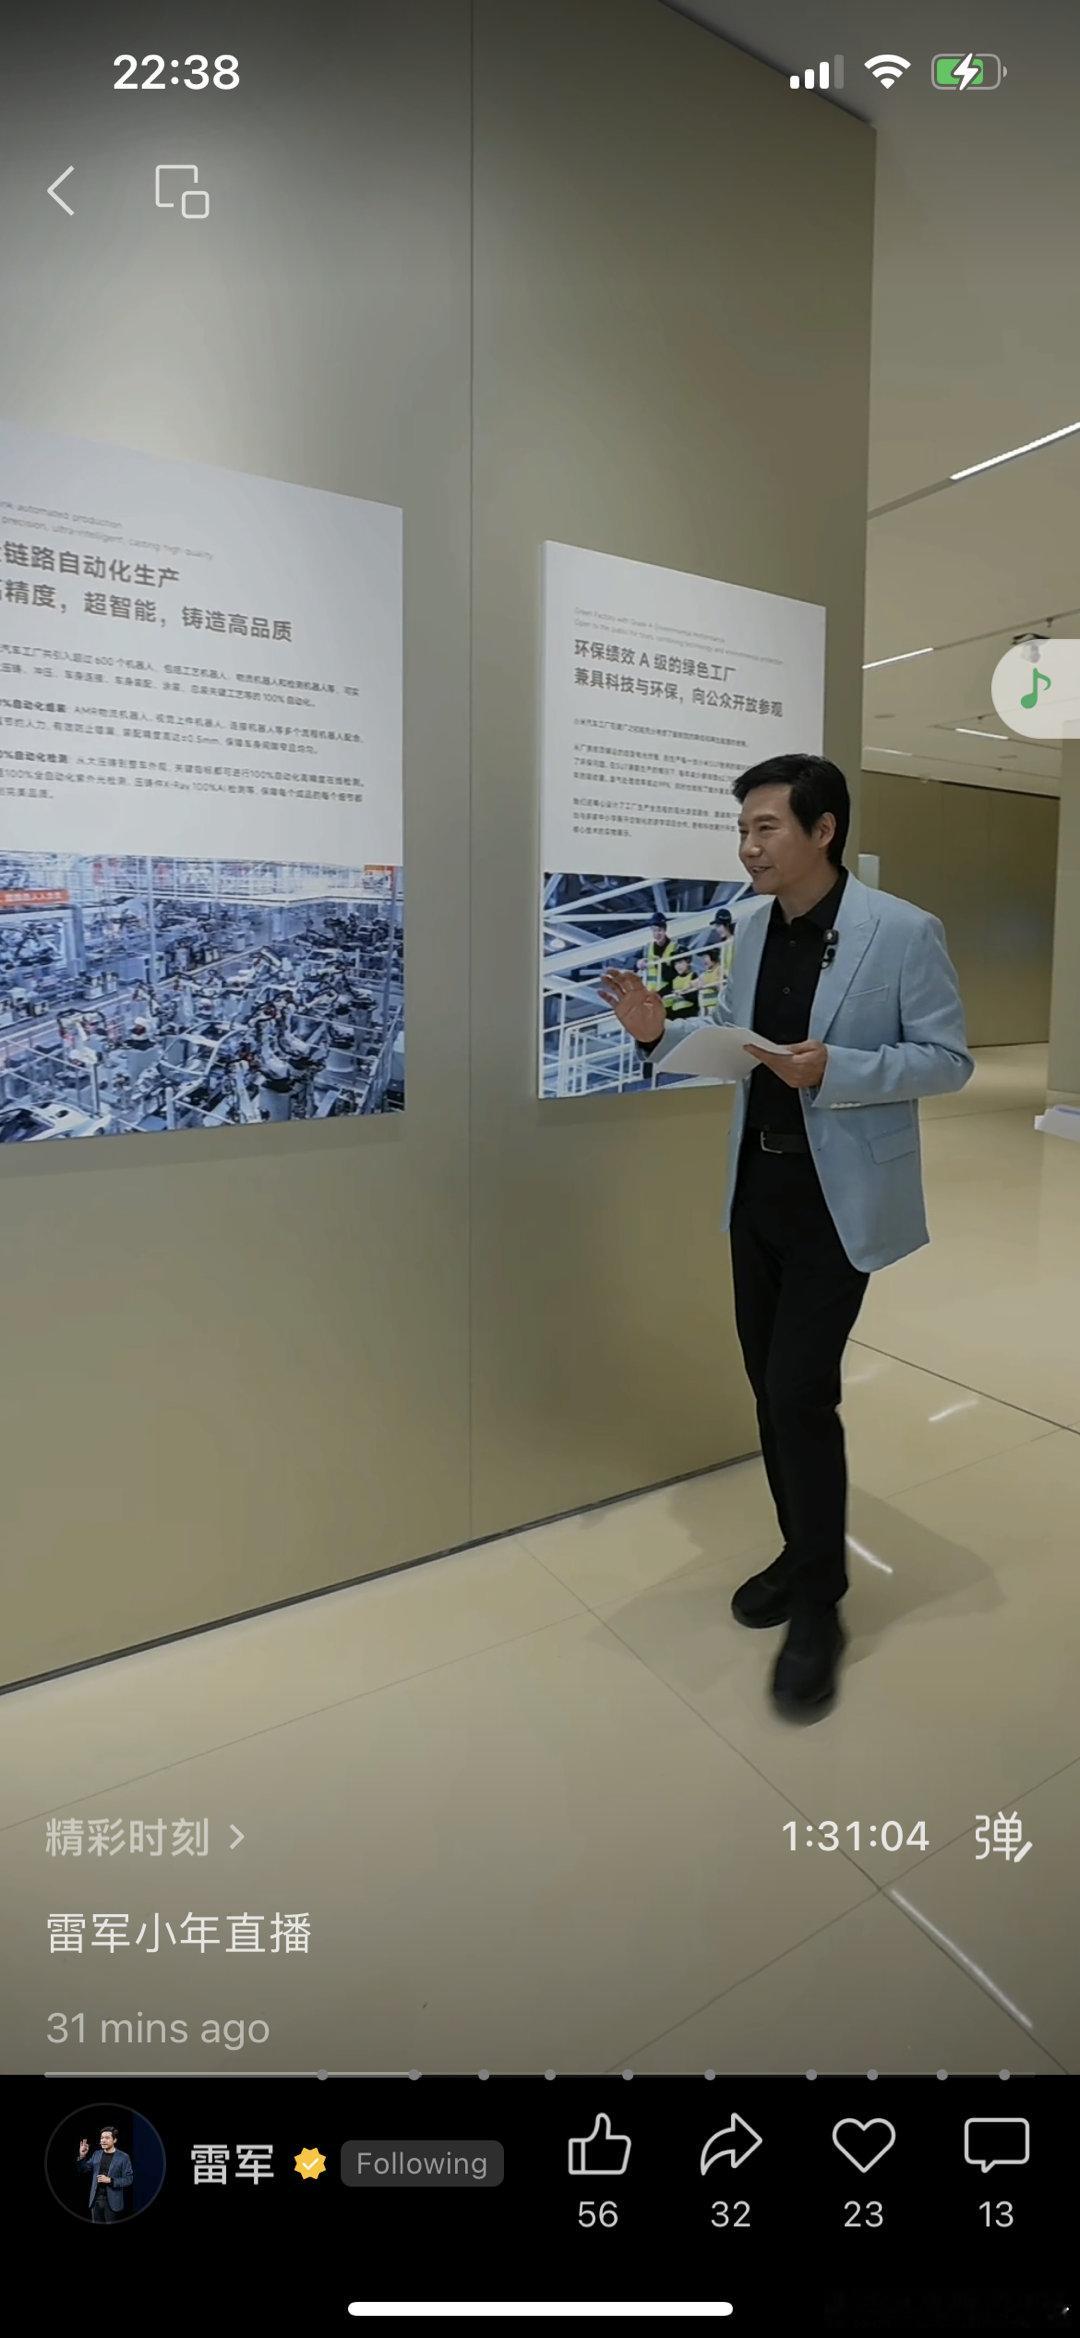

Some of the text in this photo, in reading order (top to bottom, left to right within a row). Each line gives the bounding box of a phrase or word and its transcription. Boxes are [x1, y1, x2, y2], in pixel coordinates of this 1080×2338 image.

[72, 513, 123, 529] production
[0, 541, 180, 589] 链路自动化生产
[574, 638, 737, 683] 环保绩效 A 级的绿色工厂
[574, 667, 784, 718] 兼具科技与环保，向公众开放参观
